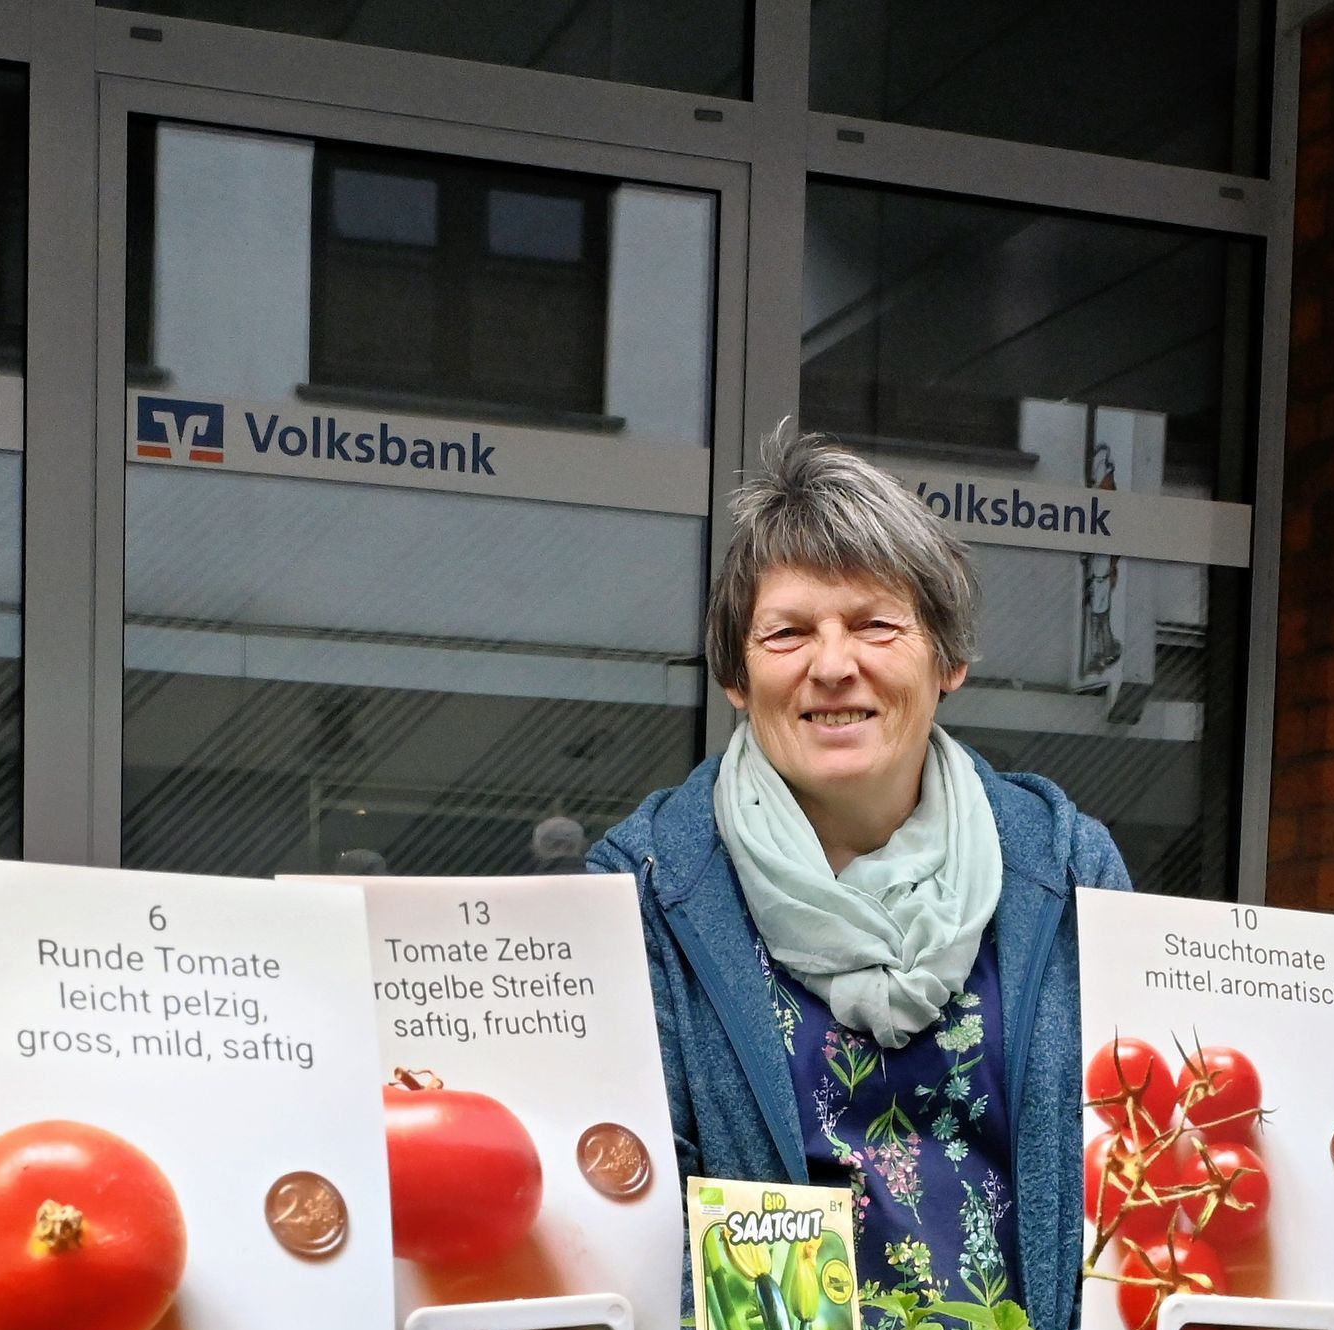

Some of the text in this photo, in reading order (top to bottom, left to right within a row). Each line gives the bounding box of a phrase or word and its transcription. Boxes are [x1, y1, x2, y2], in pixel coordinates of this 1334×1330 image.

[245, 412, 496, 476] Volksbank
[148, 905, 167, 931] 6
[458, 901, 491, 925] 13
[1230, 908, 1258, 930] 10
[38, 938, 281, 979] Runde Tomate
[384, 936, 572, 963] Tomate Zebra
[1165, 933, 1326, 971] Stauchtomate
[60, 982, 268, 1025] leicht pelzig,
[373, 971, 595, 1006] rotgelbe Streifen
[394, 1008, 587, 1043] saftig, fruchtig
[17, 1028, 314, 1069] gross, mild, saftig
[764, 1193, 786, 1211] BIO
[727, 1209, 824, 1243] SAATGUT
